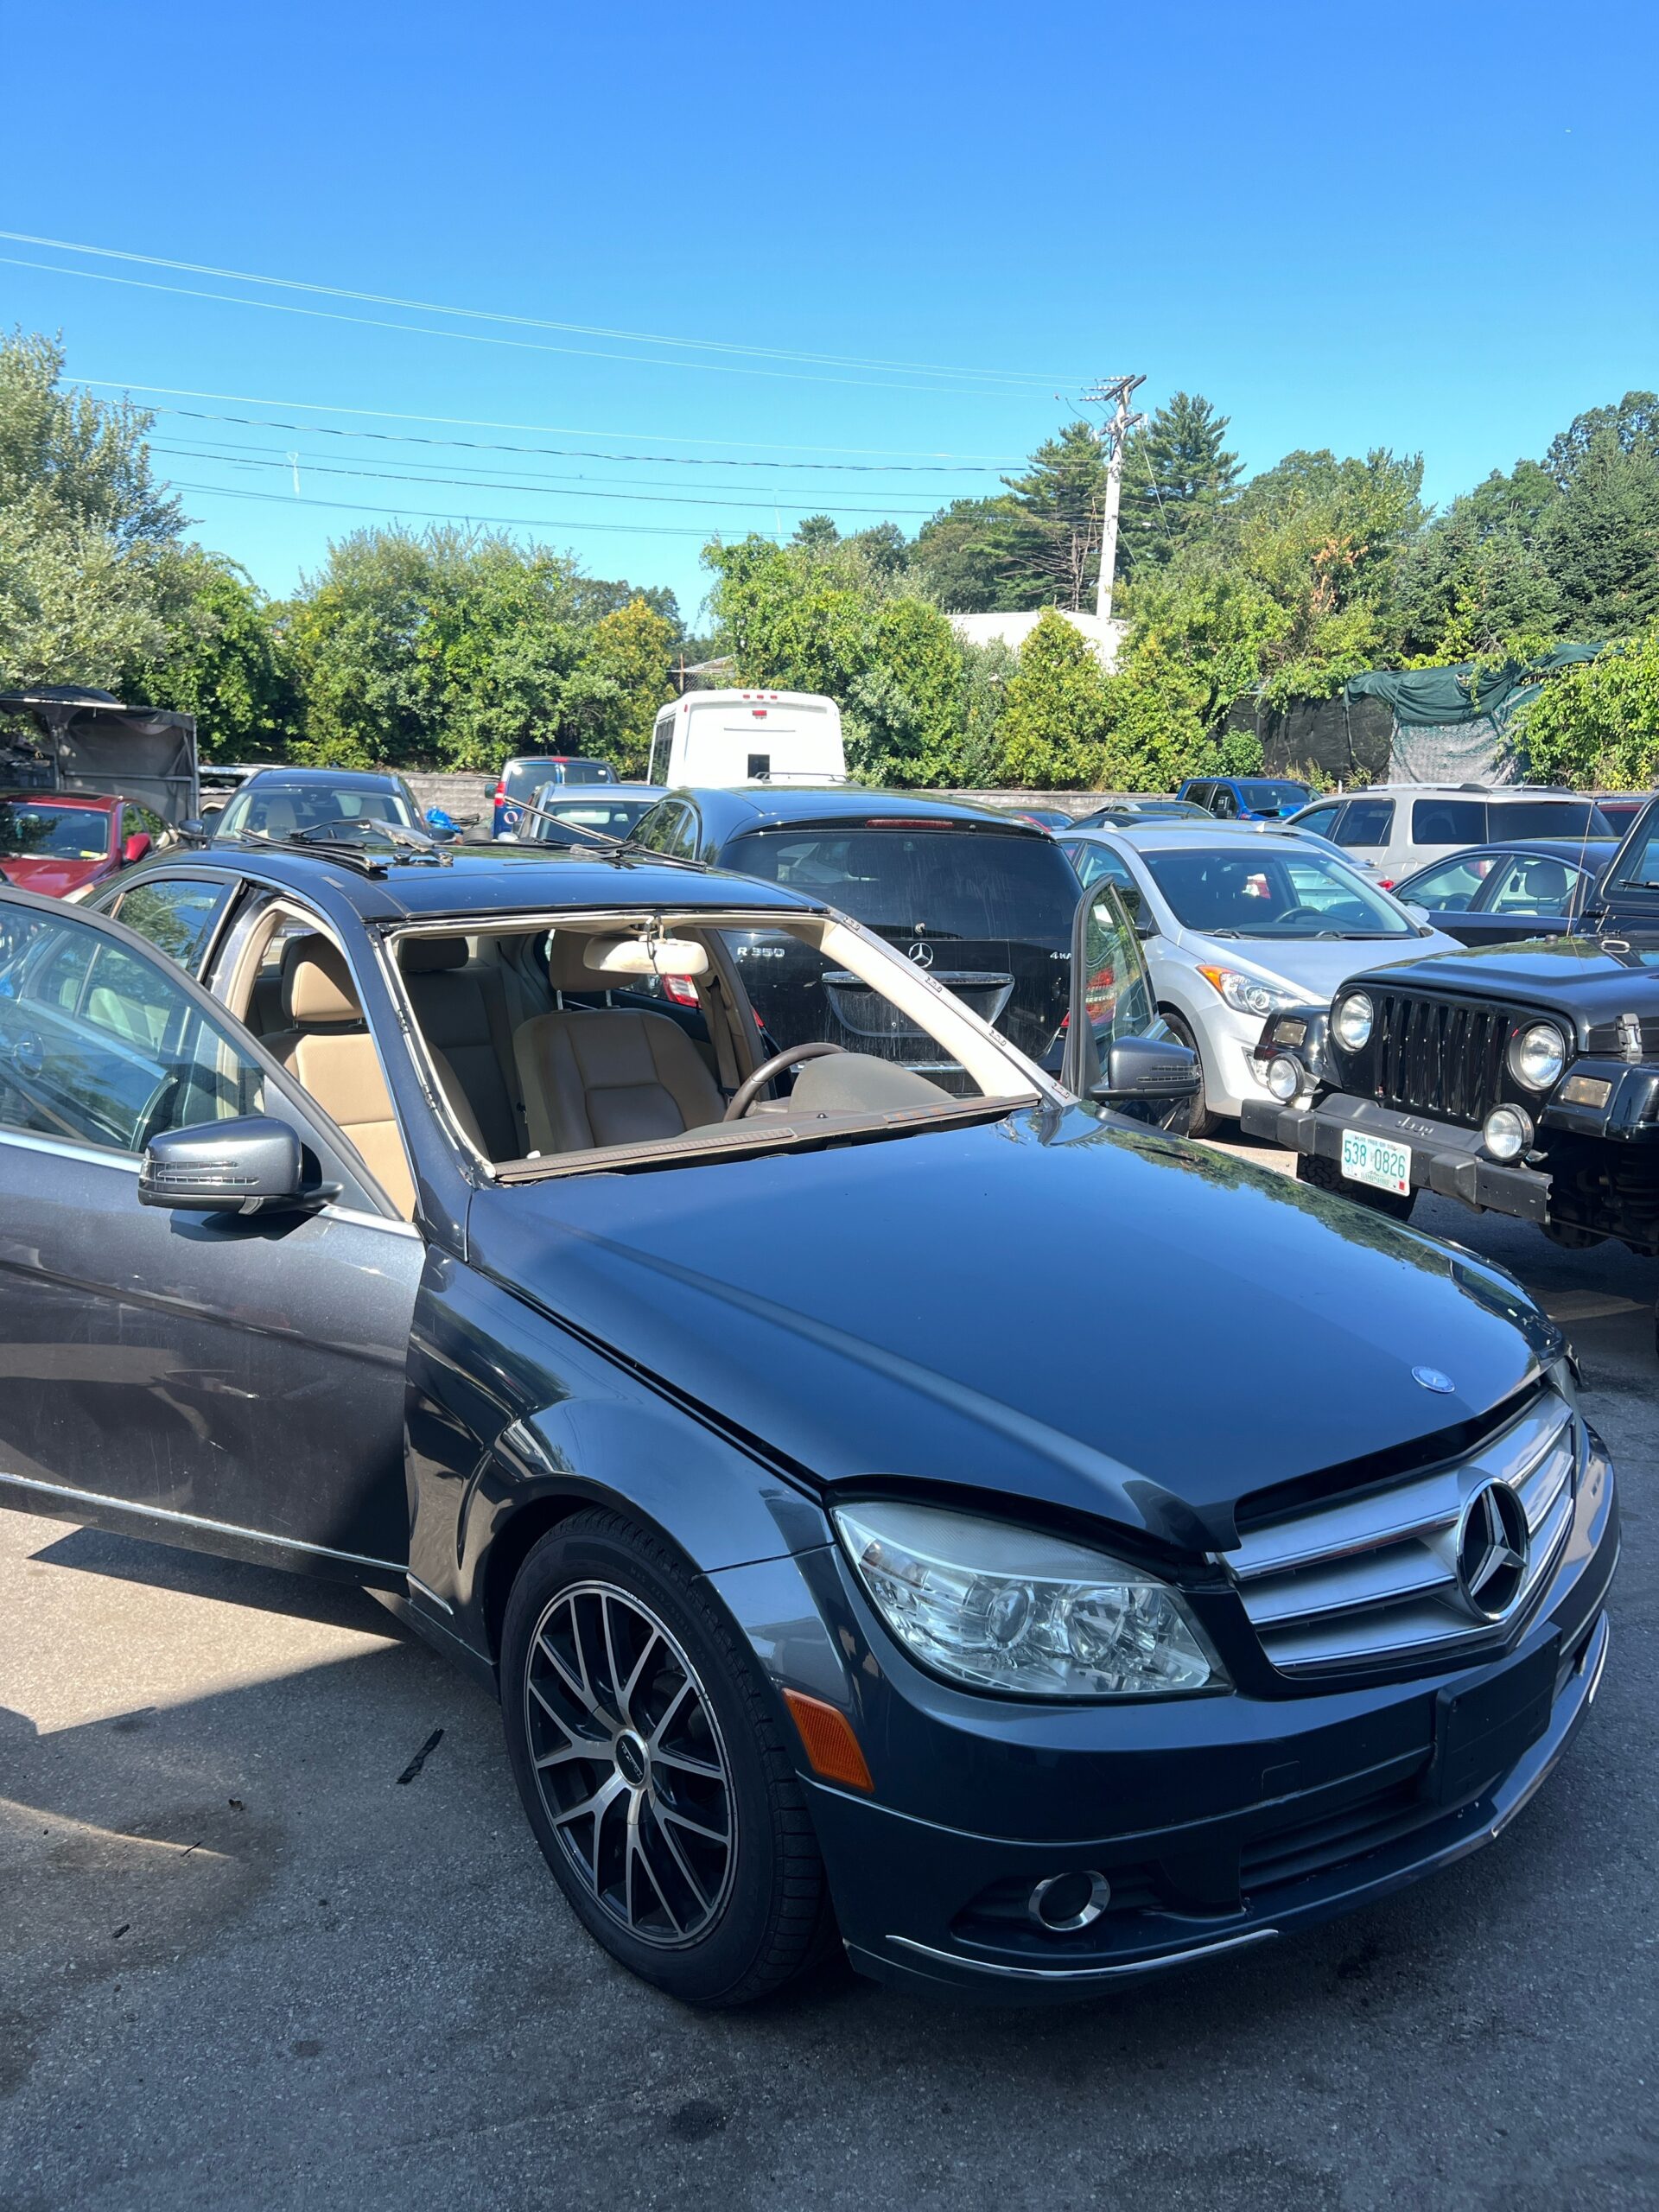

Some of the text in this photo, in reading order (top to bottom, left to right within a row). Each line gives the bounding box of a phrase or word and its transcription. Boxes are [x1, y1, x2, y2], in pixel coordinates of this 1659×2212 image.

[737, 946, 785, 957] R 350
[1395, 1116, 1434, 1136] Jeep
[1344, 1140, 1406, 1179] 538 0826
